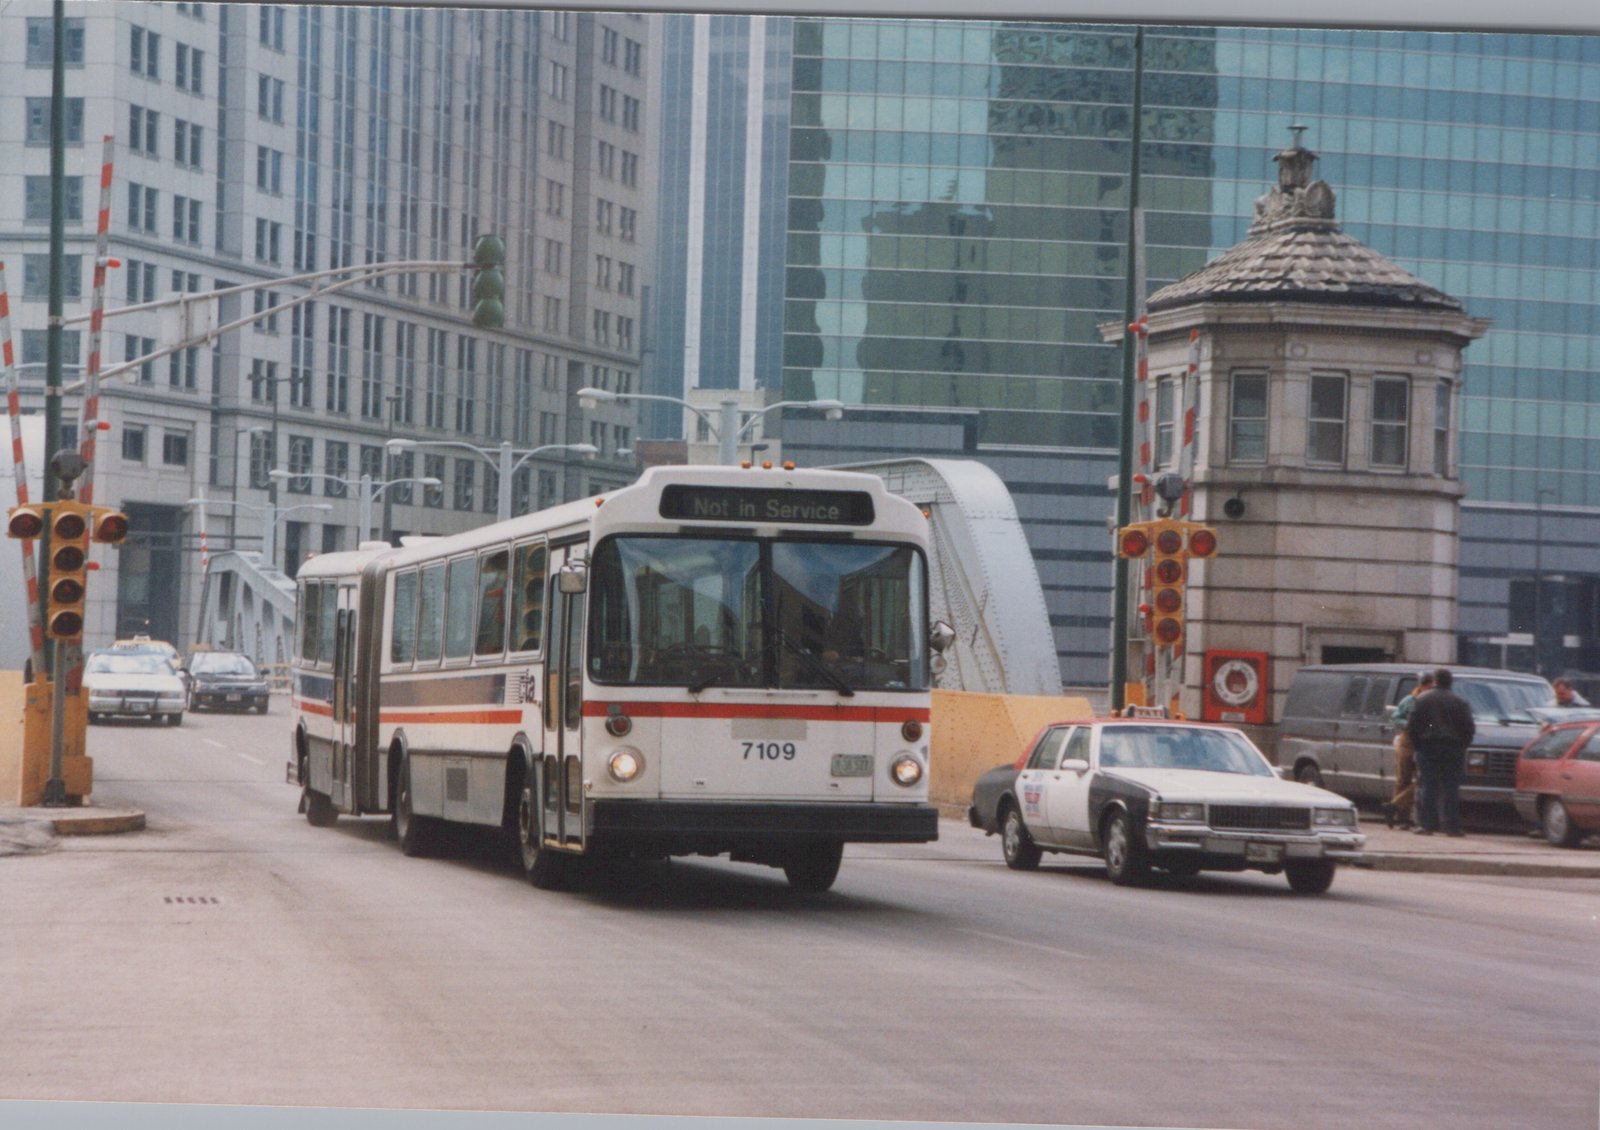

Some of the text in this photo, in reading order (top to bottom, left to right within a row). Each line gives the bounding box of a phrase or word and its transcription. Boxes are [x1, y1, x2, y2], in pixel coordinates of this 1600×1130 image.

[694, 498, 840, 520] Not in Service
[742, 742, 797, 761] 7109
